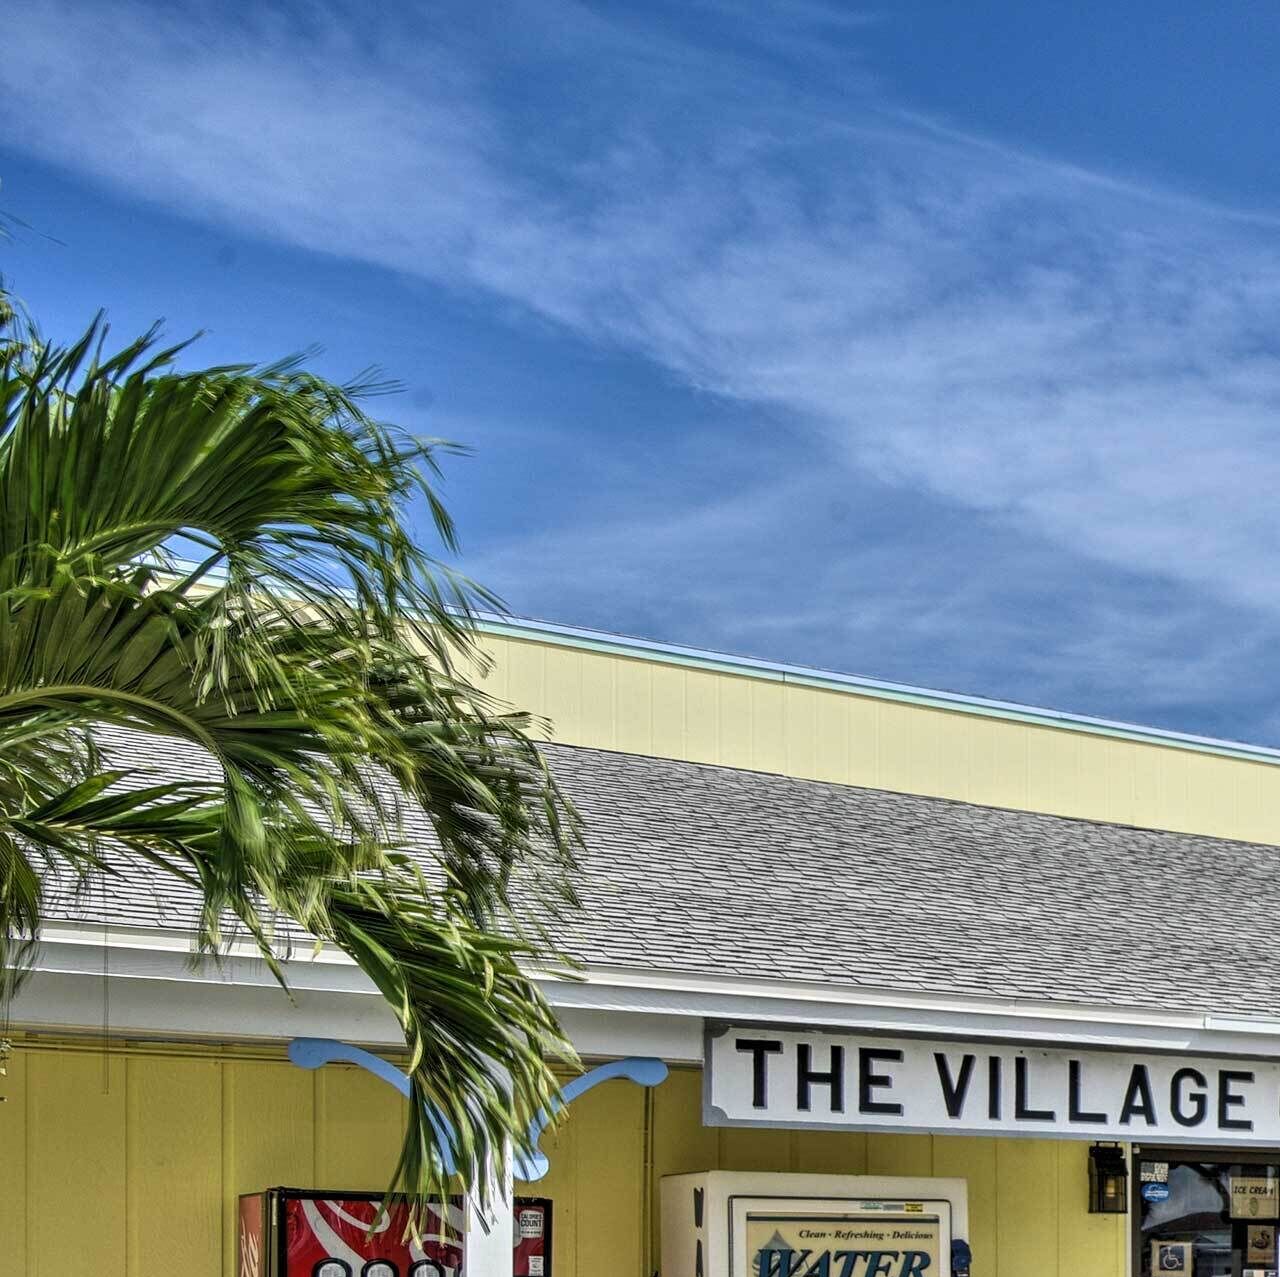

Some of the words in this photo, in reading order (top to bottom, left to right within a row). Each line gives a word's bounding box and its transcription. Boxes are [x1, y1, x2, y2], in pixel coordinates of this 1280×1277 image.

[735, 1038, 904, 1116] THE
[933, 1052, 1255, 1131] VILLAGE
[1233, 1186, 1247, 1194] ICE
[521, 1220, 542, 1228] COUNT
[799, 1230, 827, 1239] Clean
[834, 1230, 885, 1240] Refreshing
[892, 1231, 934, 1239] Delicious
